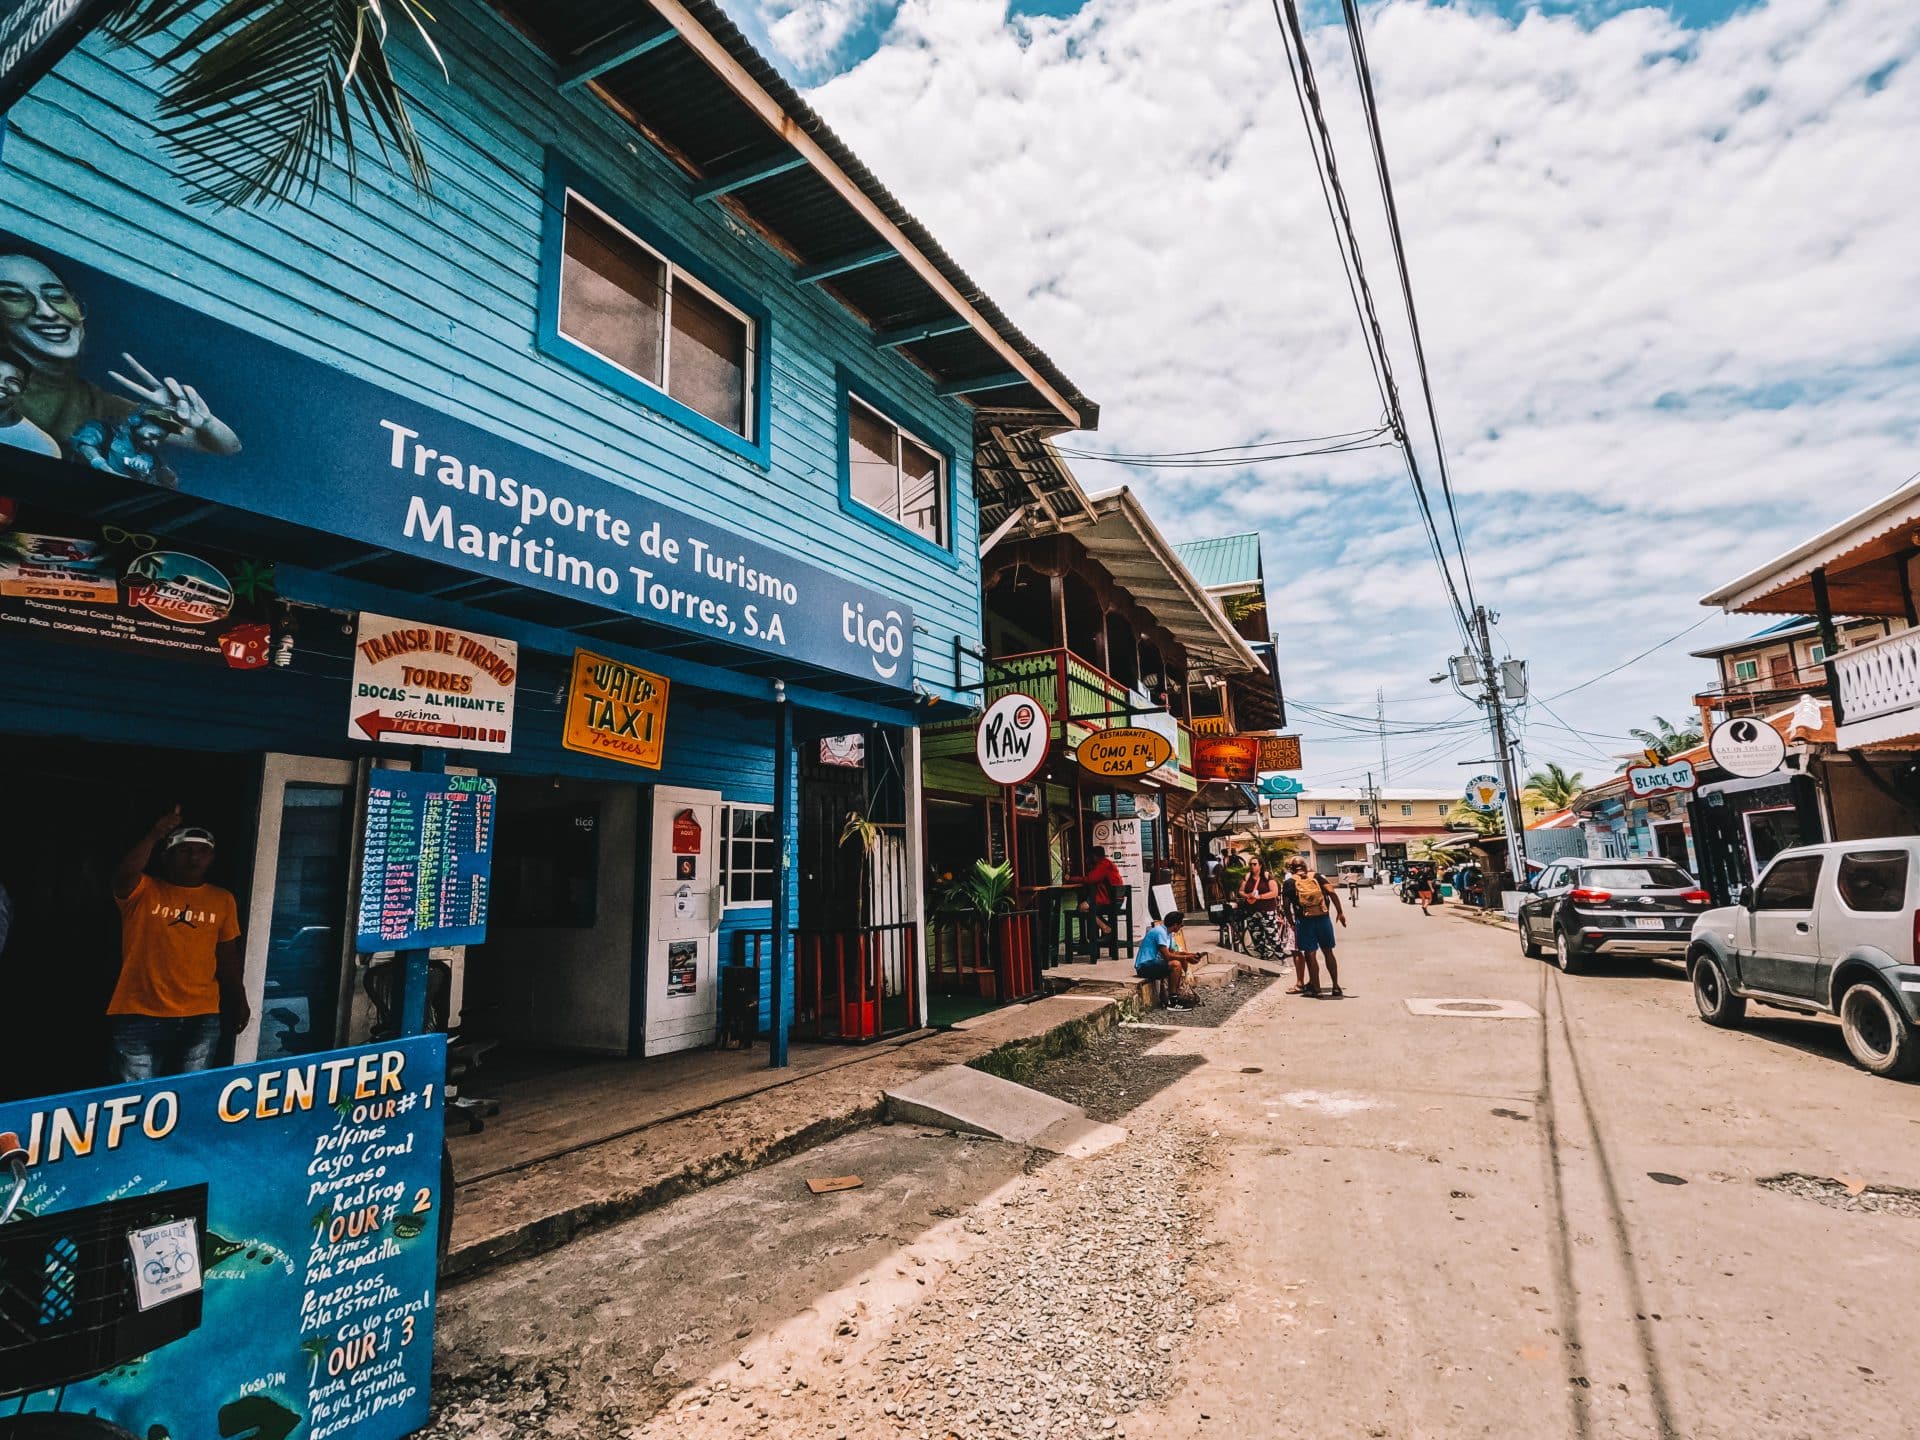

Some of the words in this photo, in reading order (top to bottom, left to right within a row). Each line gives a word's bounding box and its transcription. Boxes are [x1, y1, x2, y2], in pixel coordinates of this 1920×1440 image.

[380, 419, 630, 547] Transporte
[640, 522, 679, 564] de
[687, 538, 798, 605] Turismo
[403, 496, 620, 596] Marítimo
[629, 566, 737, 635] Torres,
[744, 613, 787, 645] S.A
[69, 607, 88, 617] and
[89, 608, 114, 621] Costa
[357, 628, 431, 666] TRANSP.
[433, 629, 456, 656] DE
[458, 634, 516, 687] TURISMO
[401, 665, 474, 695] TORRES
[358, 683, 407, 702] BOCAS
[424, 693, 506, 713] ALMIRANTE
[394, 708, 442, 721] oficina
[583, 693, 655, 744] TAXI
[590, 728, 646, 755] Torres
[985, 711, 1032, 760] RAW
[1264, 738, 1298, 750] HOTEL
[1090, 743, 1127, 761] COMO
[1102, 760, 1133, 773] CASA
[1264, 750, 1299, 760] BOCAS
[397, 789, 408, 799] TO
[448, 775, 487, 792] Shuttle
[1635, 772, 1673, 789] BLACK
[1672, 769, 1690, 783] CAT
[24, 1090, 179, 1168] INFO
[217, 1049, 407, 1124] CENTER
[314, 1124, 387, 1157] Delfines
[307, 1153, 354, 1181] Cayo
[361, 1132, 414, 1165] Coral
[306, 1236, 370, 1270] Delfines
[334, 1237, 402, 1276] Zapatilla
[310, 1394, 353, 1427] Playa
[371, 1386, 417, 1418] Drago
